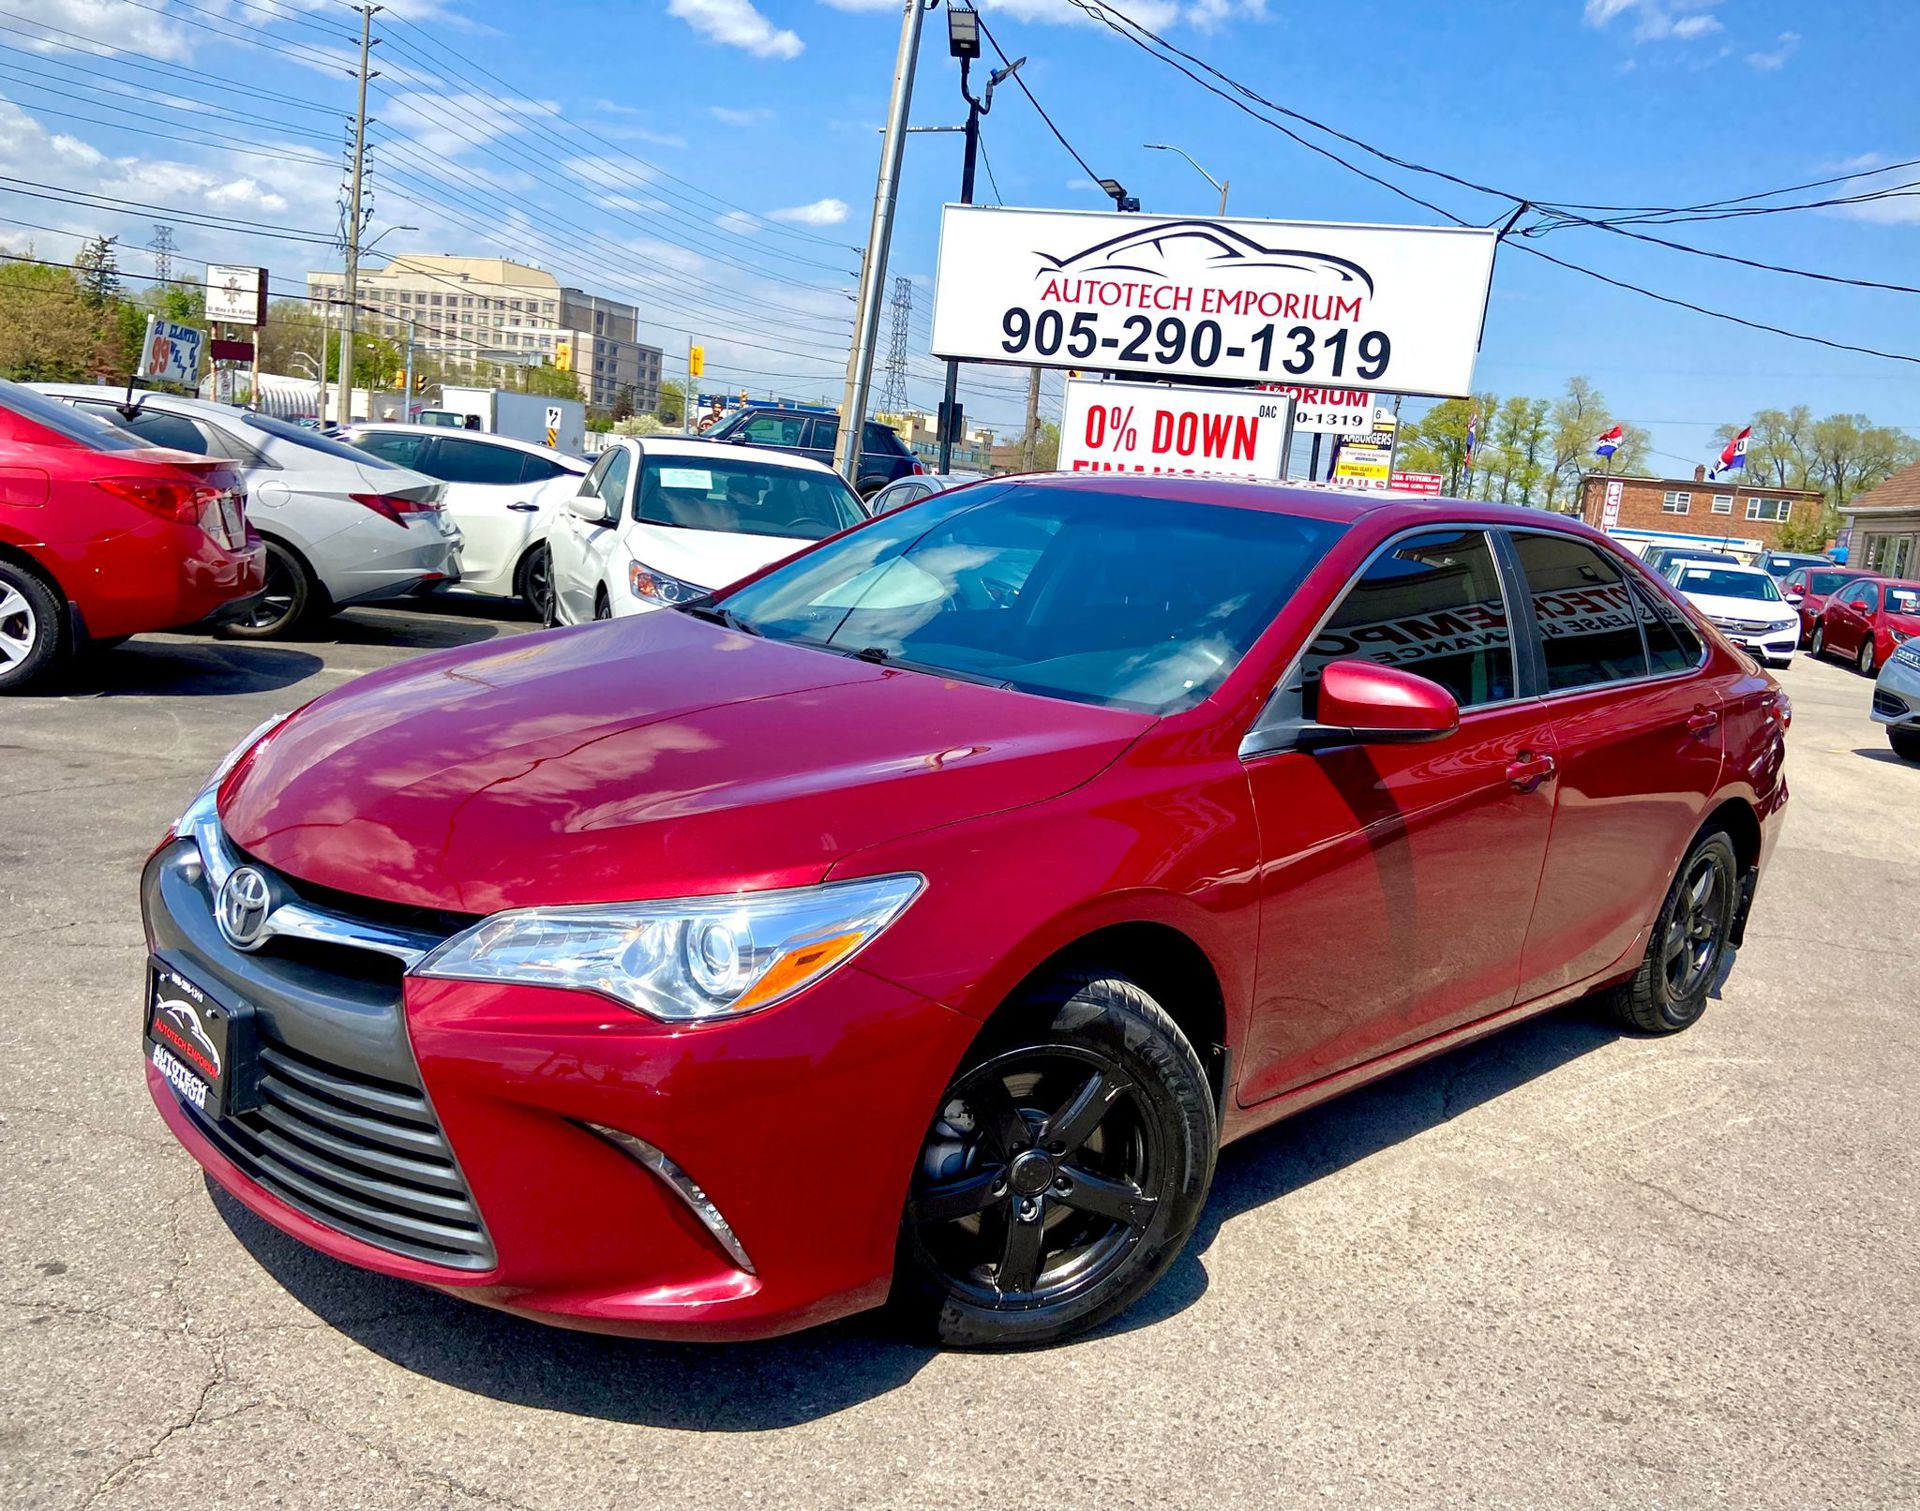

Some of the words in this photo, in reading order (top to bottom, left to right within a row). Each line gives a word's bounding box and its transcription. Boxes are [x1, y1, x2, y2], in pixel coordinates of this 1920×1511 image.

[1040, 278, 1193, 311] AUTOTECH
[1200, 288, 1362, 322] EMPORIUM
[1001, 306, 1391, 380] 905-290-1319
[1257, 384, 1369, 407] ORIUM
[1259, 405, 1277, 419] OAC
[1085, 404, 1137, 452] 0%
[1151, 410, 1260, 461] DOWN
[1341, 432, 1392, 446] AMBURGERS
[155, 1017, 187, 1051] AUTOTECH
[186, 1042, 219, 1080] EMPORIUM
